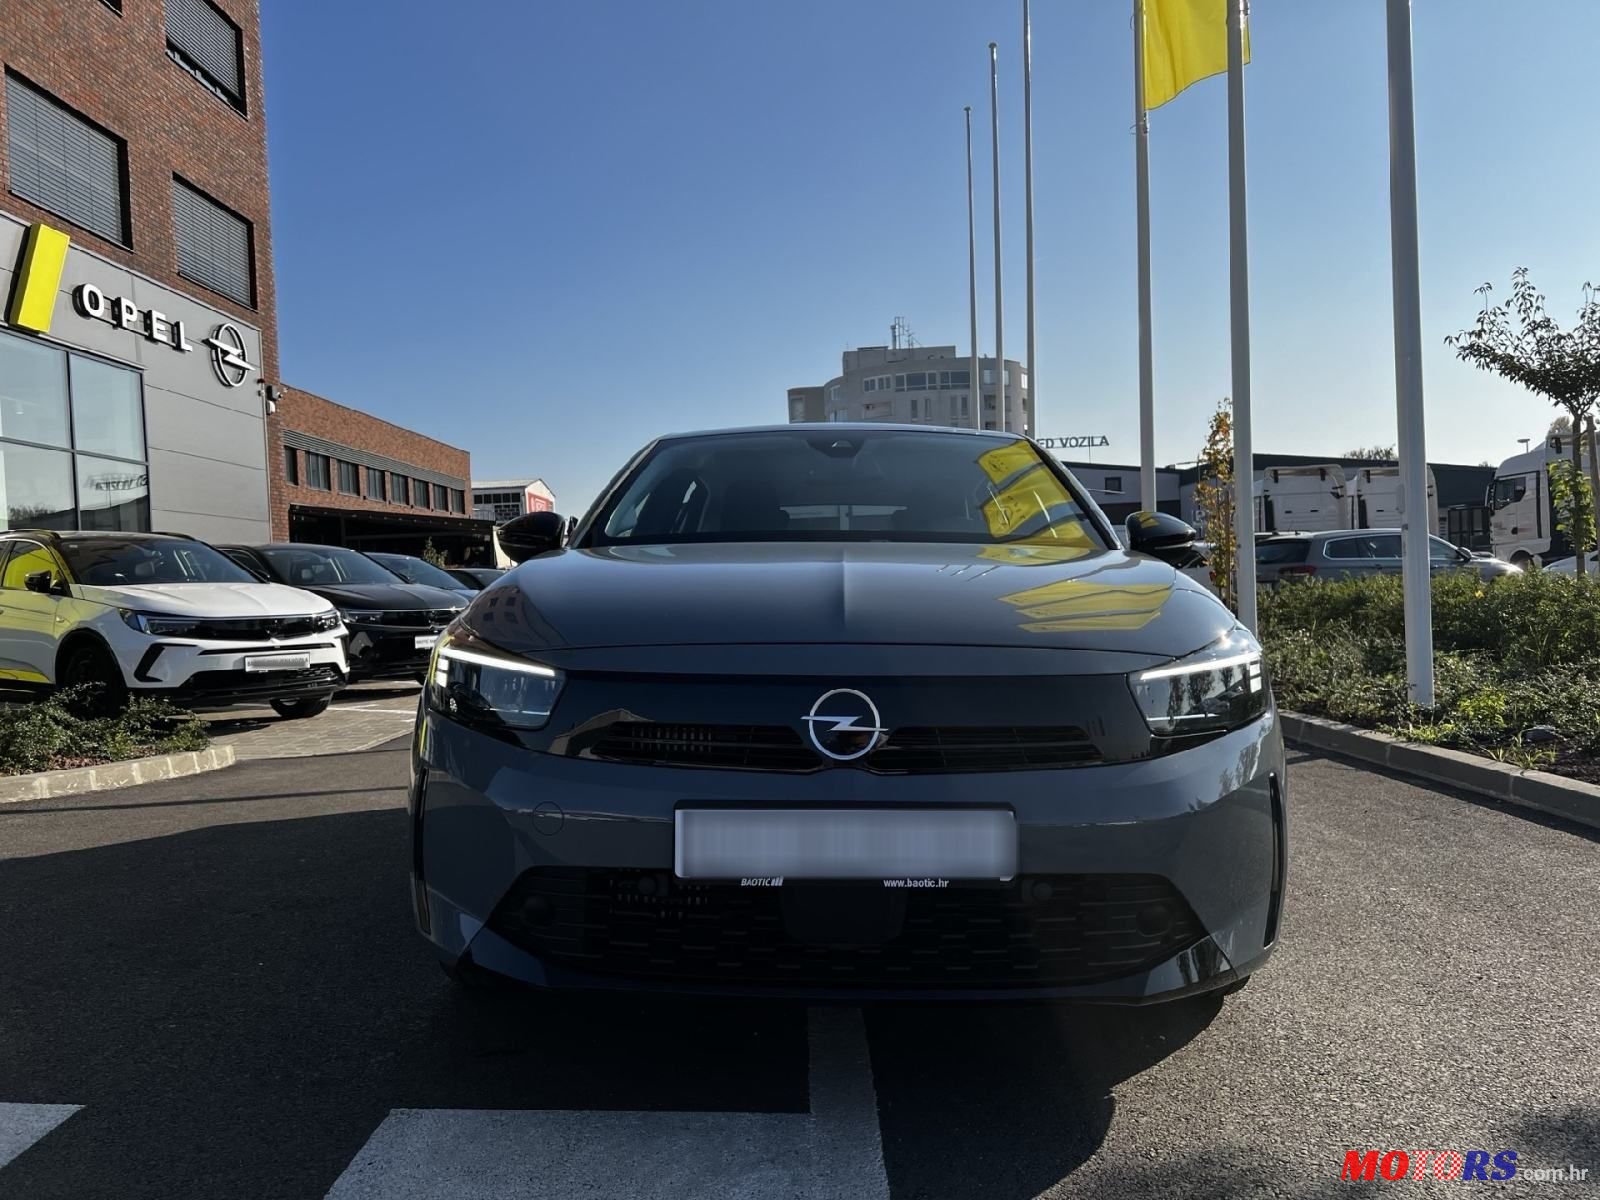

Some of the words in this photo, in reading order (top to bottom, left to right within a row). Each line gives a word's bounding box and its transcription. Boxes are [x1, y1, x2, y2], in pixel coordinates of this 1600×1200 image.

[74, 283, 192, 352] OPEL
[1060, 435, 1109, 448] VOZILA
[883, 878, 949, 888] www.baotic.hr
